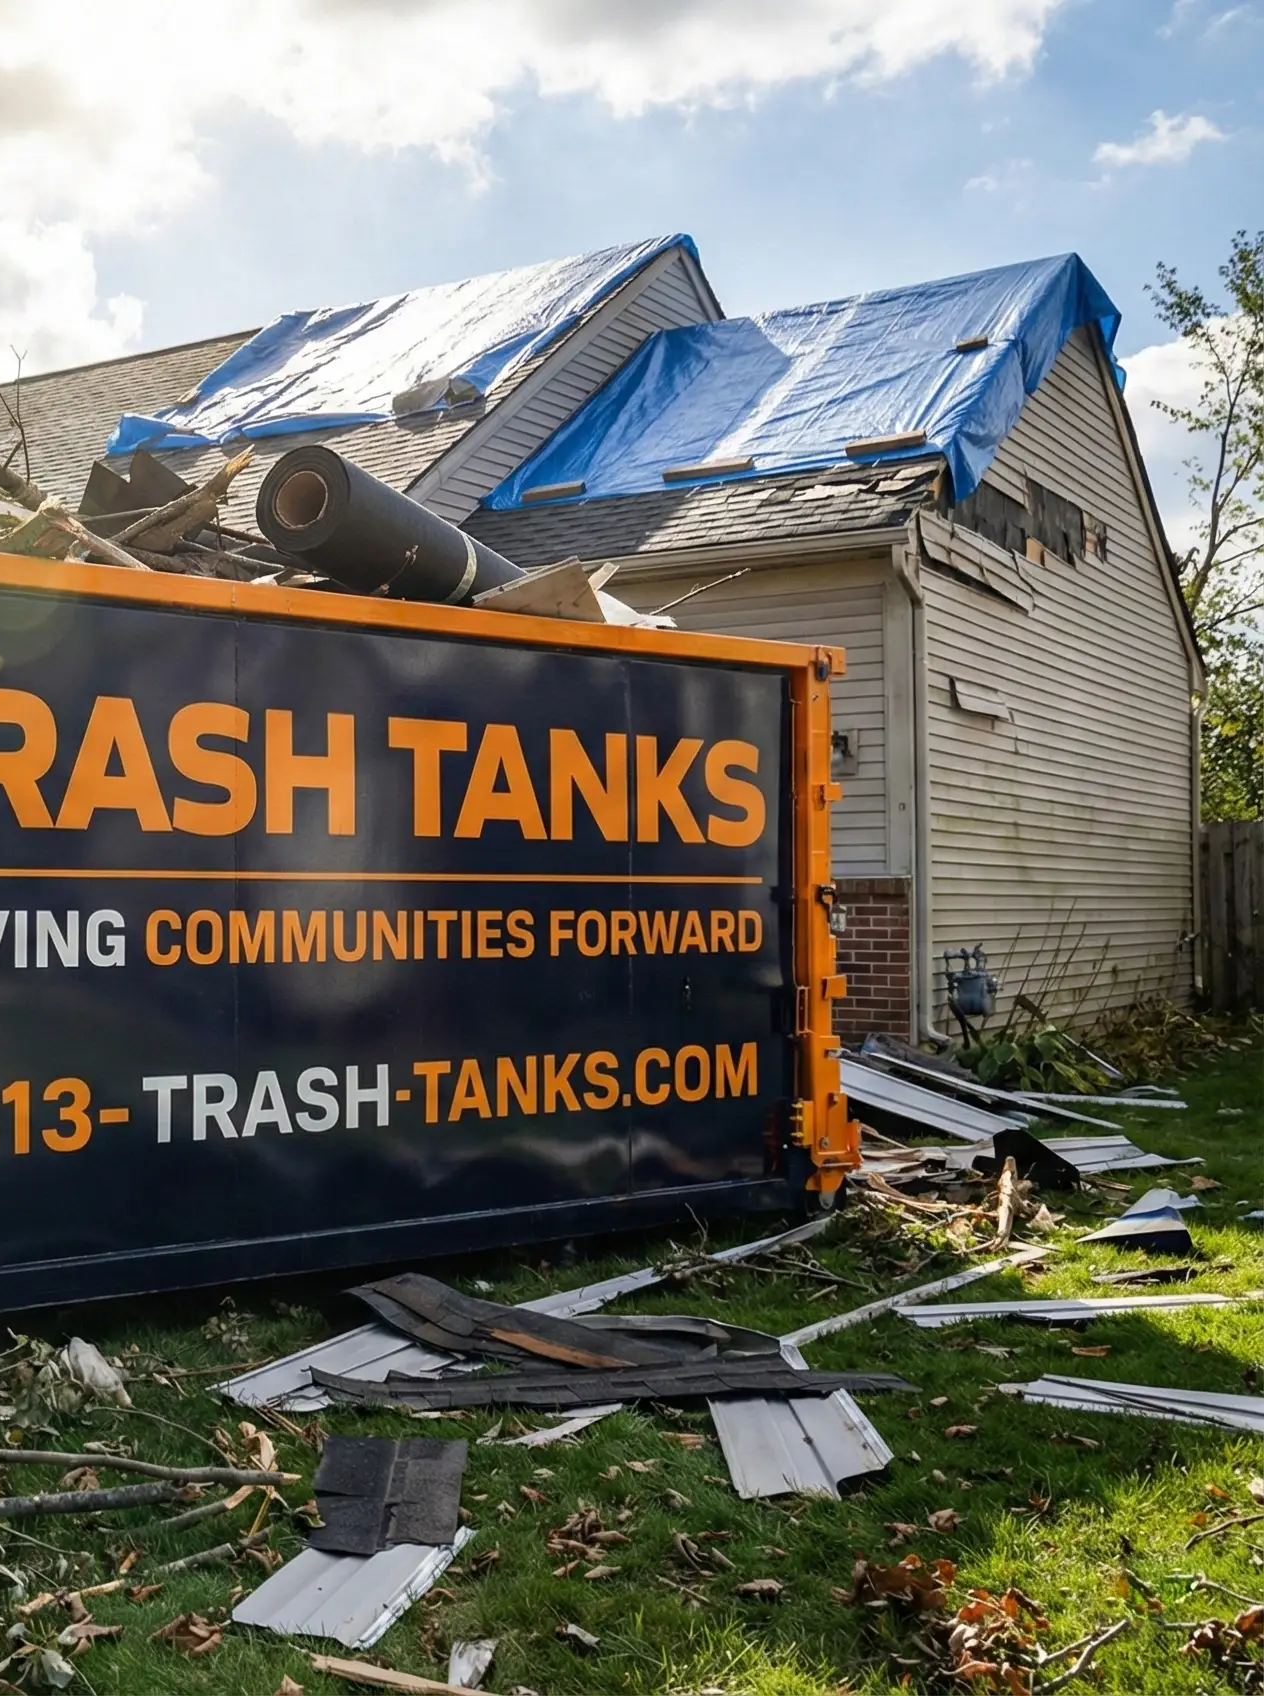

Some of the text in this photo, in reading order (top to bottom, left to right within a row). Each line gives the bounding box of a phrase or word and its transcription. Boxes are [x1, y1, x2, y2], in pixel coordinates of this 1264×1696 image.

[387, 716, 767, 848] TANKS
[145, 908, 535, 966] COMMUNITIES
[550, 909, 763, 957] FORWARD
[142, 1042, 758, 1144] TRASH-TANKS.COM
